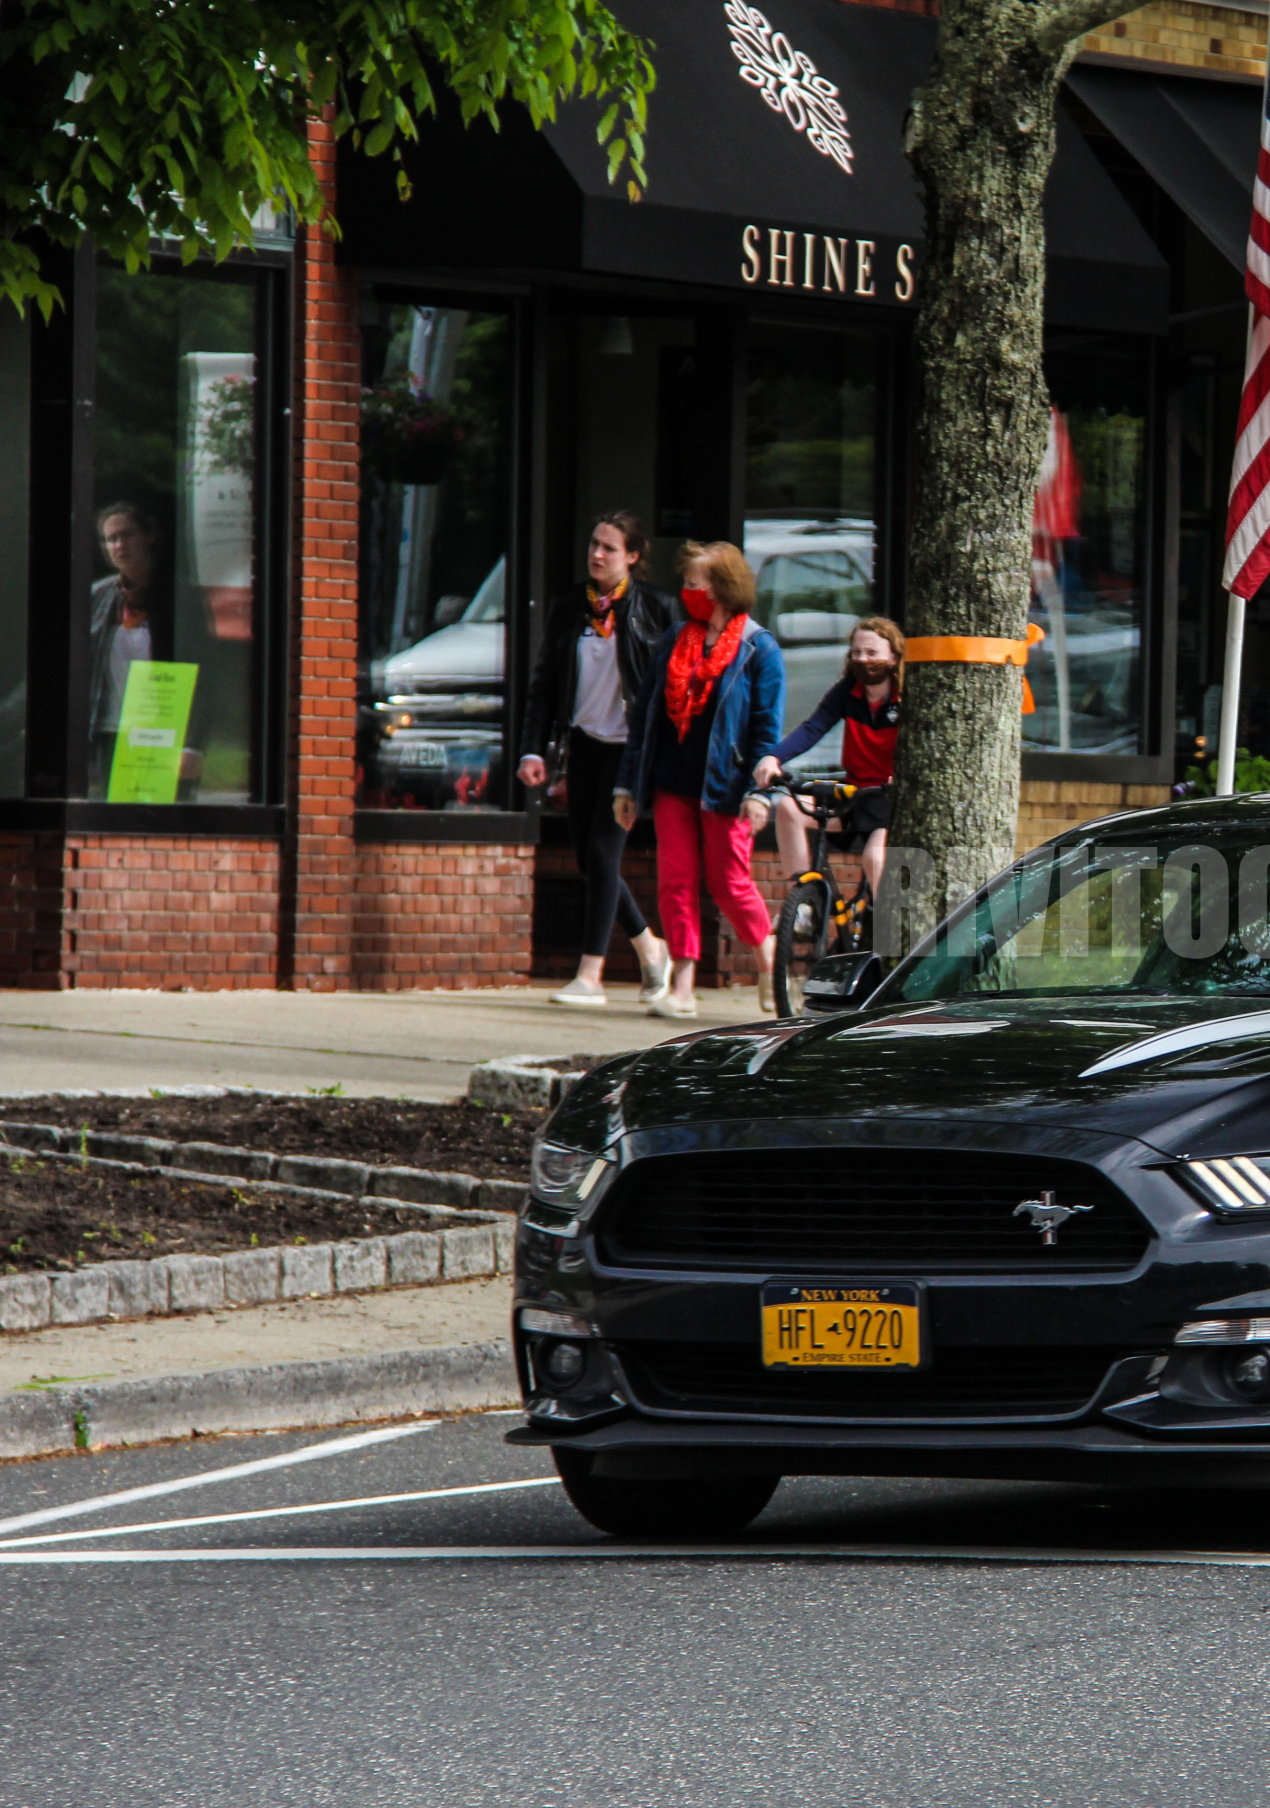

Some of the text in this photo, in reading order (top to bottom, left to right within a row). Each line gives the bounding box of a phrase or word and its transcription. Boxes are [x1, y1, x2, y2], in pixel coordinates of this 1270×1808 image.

[741, 224, 915, 301] SHINE S
[399, 742, 449, 767] AVEDA
[801, 1289, 881, 1301] NEW YORK
[778, 1308, 903, 1349] HFL 9220
[802, 1353, 882, 1363] EMPIRE STATE
